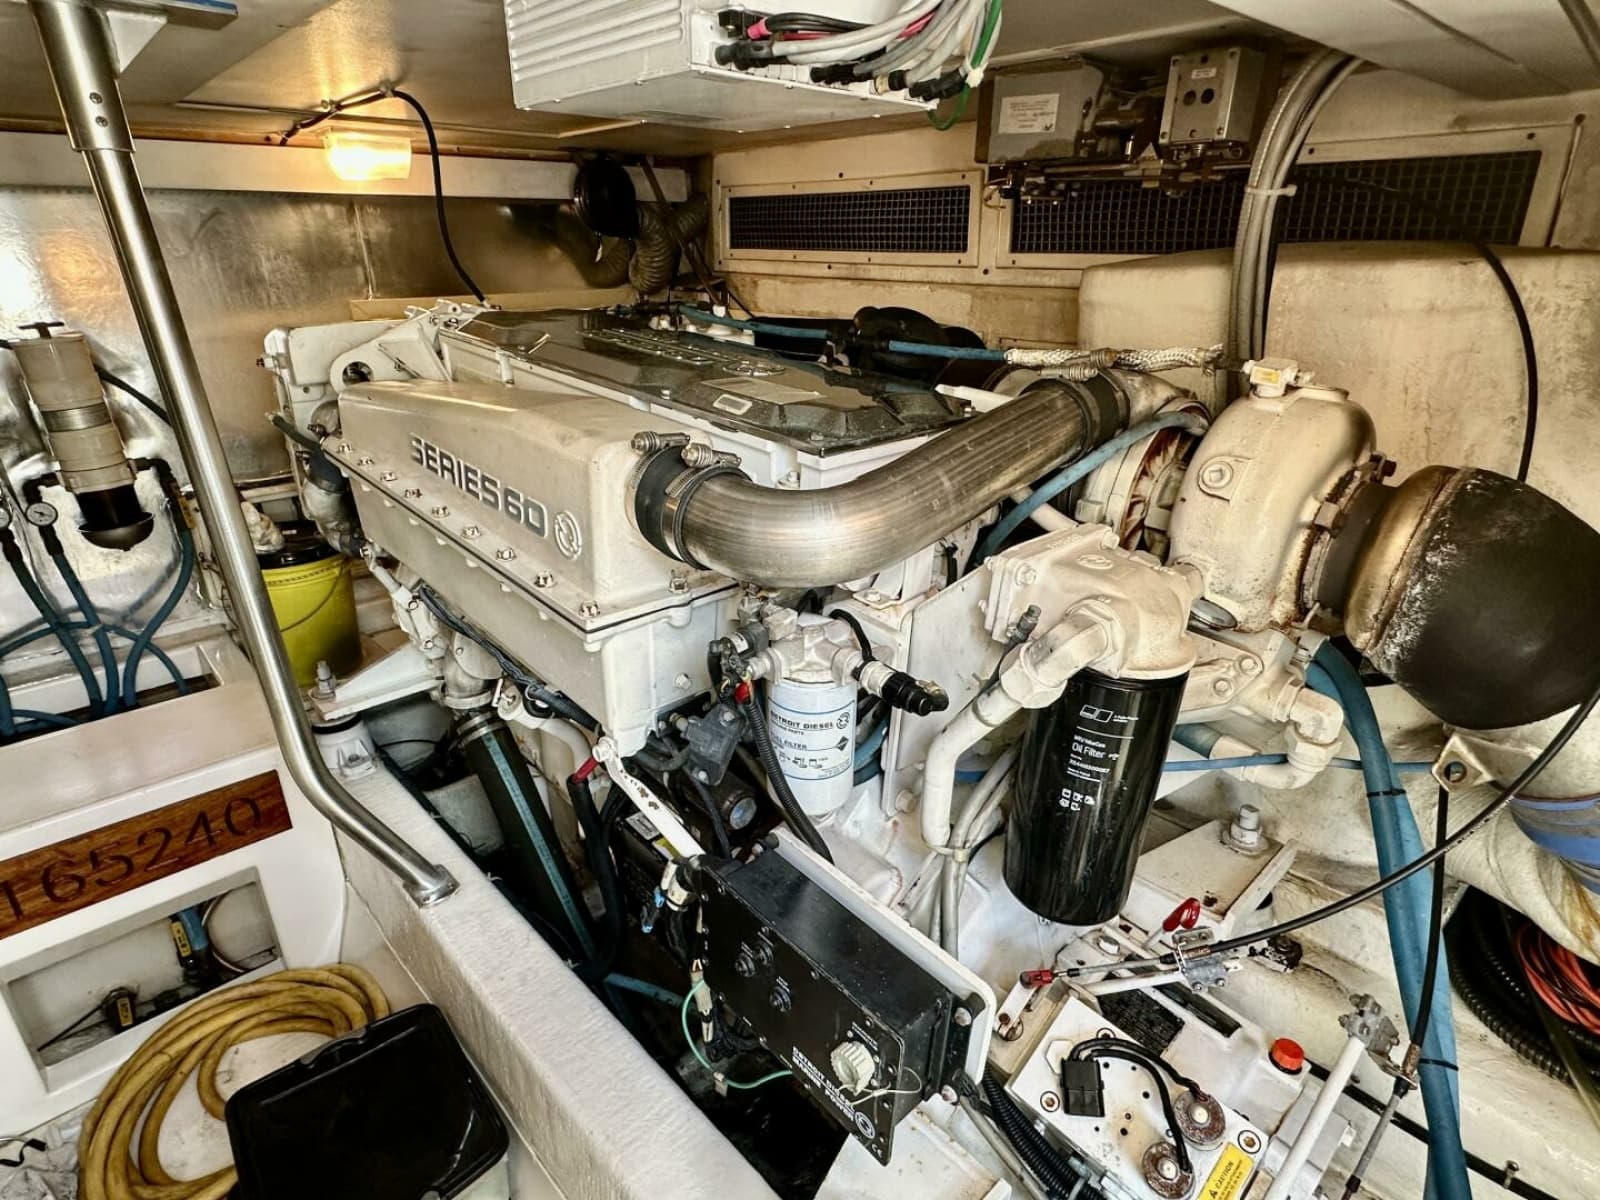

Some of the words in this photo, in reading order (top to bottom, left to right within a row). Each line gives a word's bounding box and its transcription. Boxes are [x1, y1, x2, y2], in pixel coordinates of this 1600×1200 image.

[410, 433, 501, 511] SERIES
[503, 486, 548, 539] 60
[803, 721, 833, 730] DIESEL
[1072, 742, 1082, 753] Oil
[1084, 746, 1106, 759] Filter
[1215, 1160, 1234, 1189] CAUTION
